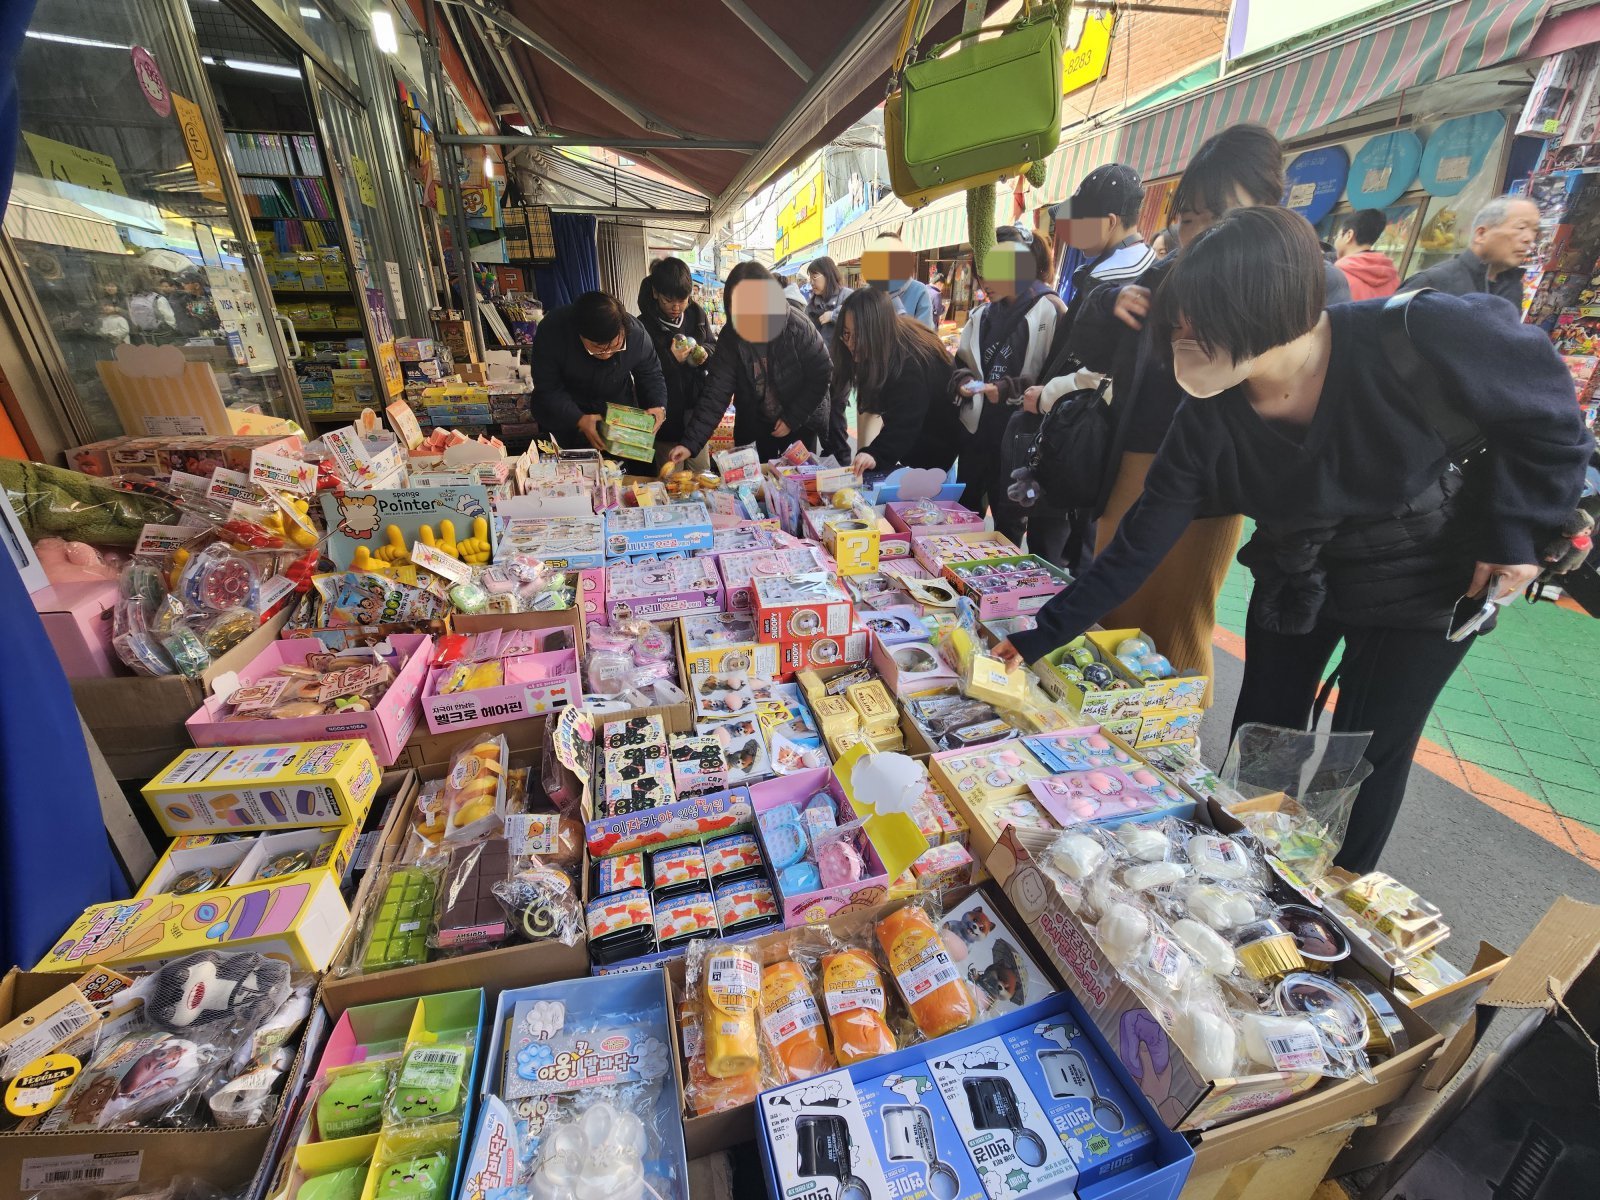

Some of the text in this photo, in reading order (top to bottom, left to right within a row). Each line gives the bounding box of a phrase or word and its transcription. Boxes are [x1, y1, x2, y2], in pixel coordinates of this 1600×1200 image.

[219, 299, 234, 310] VISA
[392, 491, 420, 499] sponge
[379, 498, 437, 513] Pointer
[657, 595, 678, 603] Kuromi
[771, 611, 779, 639] SNOOPY
[792, 642, 800, 667] SNOOPY
[434, 701, 523, 726] 벨크로 헤어핀
[566, 707, 578, 723] CAT
[708, 776, 723, 785] CAT
[611, 799, 725, 835] 이자카야 인형 키링
[456, 930, 487, 939] SQUISHY
[1062, 919, 1092, 963] 쫀쫀한
[537, 1052, 577, 1081] 야옹!
[1019, 1055, 1028, 1063] LED
[946, 1092, 957, 1100] LED
[1053, 1106, 1090, 1130] 현미경
[774, 1133, 784, 1141] LED
[972, 1139, 1011, 1164] 현미경
